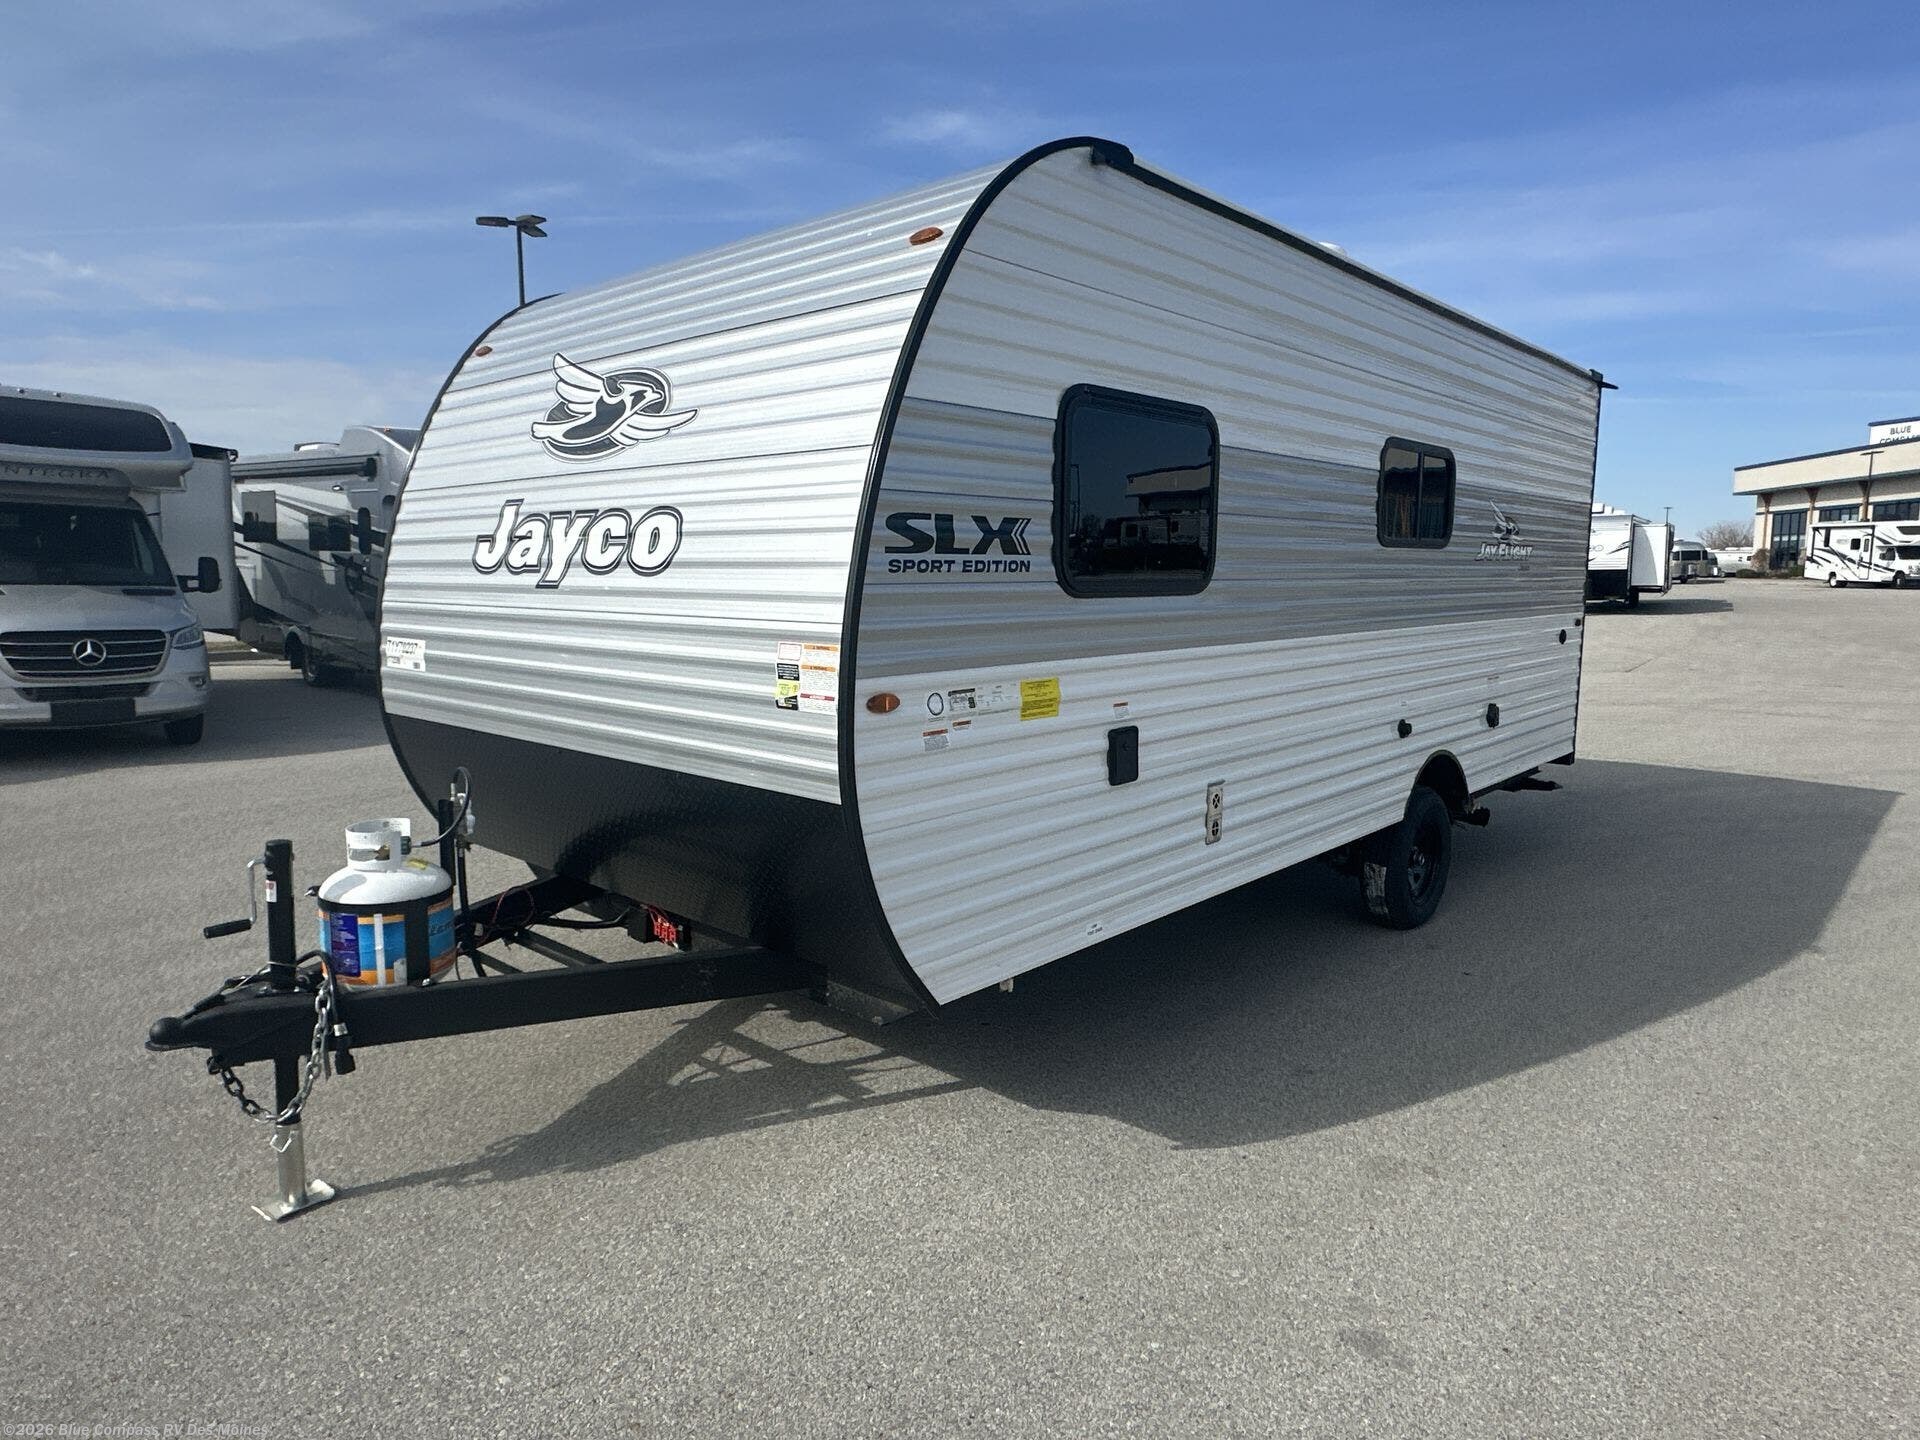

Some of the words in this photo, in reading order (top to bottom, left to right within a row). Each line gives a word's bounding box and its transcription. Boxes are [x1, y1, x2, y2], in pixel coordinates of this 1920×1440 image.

[1890, 425, 1912, 435] BLUE
[472, 498, 684, 589] Jayco
[885, 512, 1032, 555] SLX
[888, 559, 956, 574] SPORT
[962, 560, 1031, 573] EDITION
